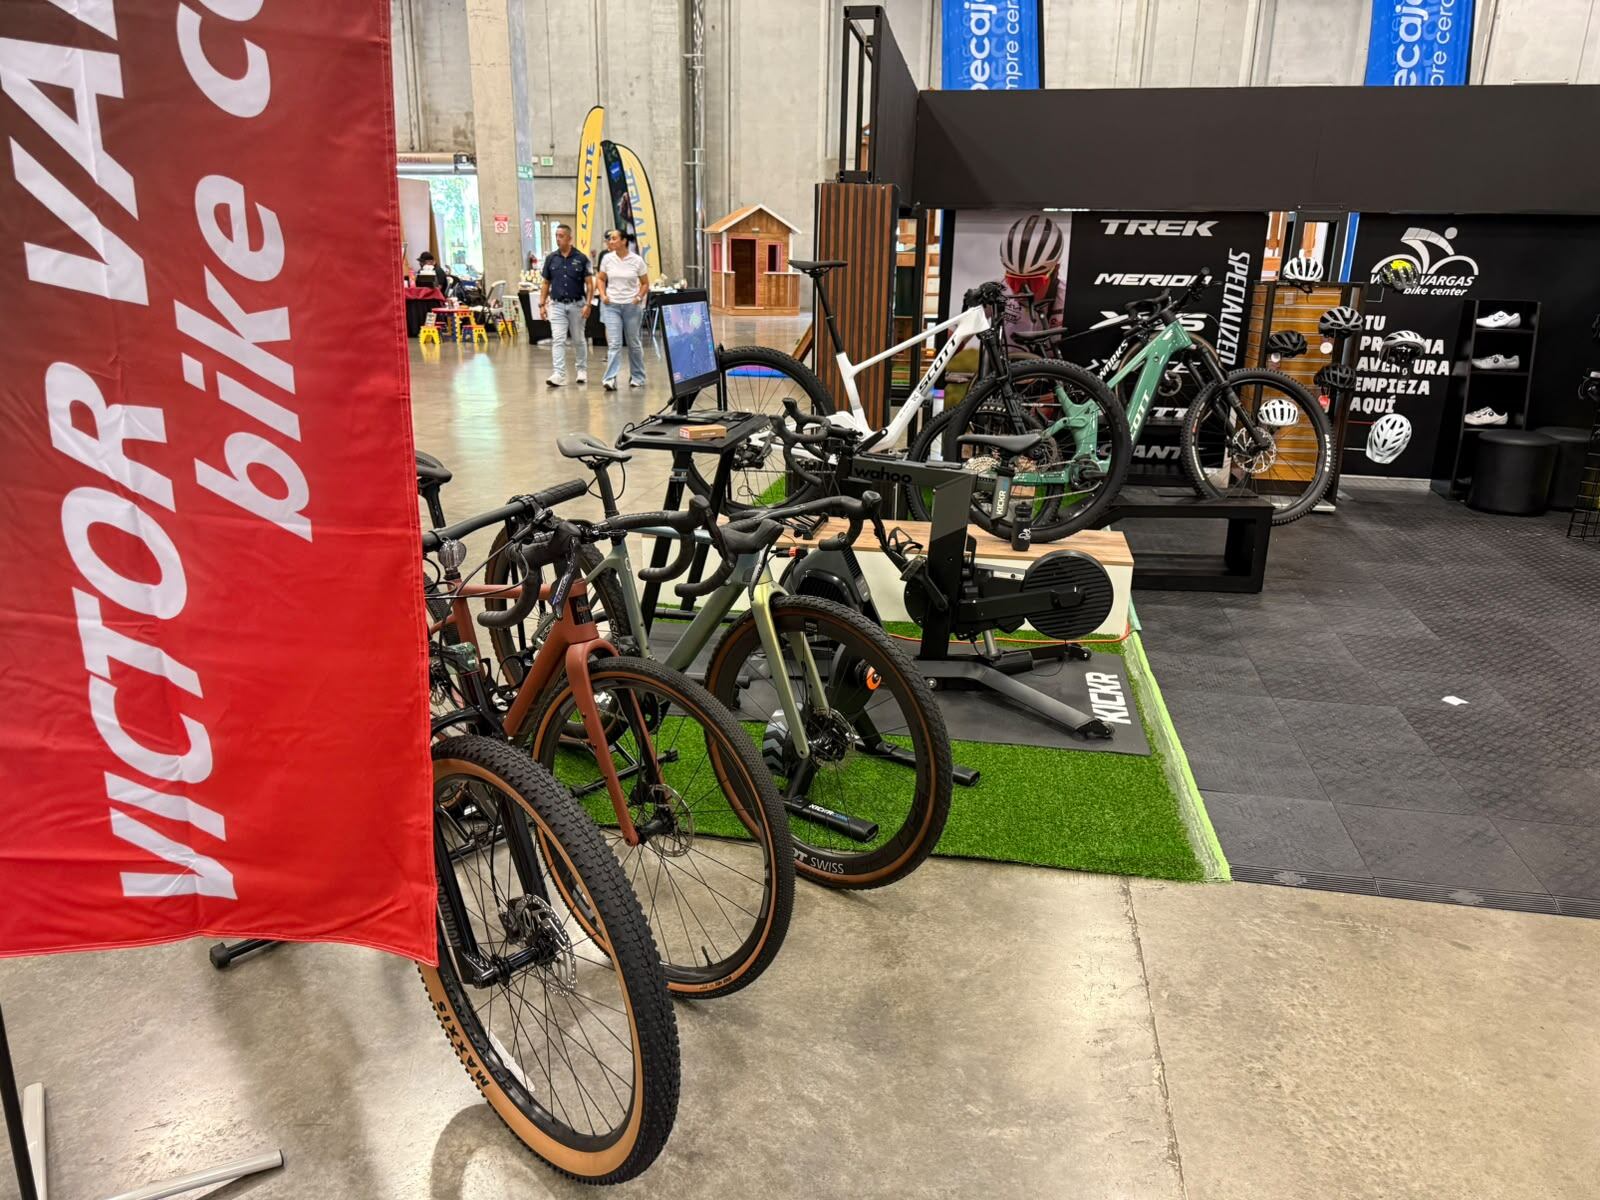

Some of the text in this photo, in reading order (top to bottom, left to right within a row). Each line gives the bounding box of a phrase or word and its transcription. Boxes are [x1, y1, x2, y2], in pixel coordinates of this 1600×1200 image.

[1100, 219, 1220, 237] TREK
[174, 0, 313, 543] bike c
[1420, 274, 1475, 286] VARGAS
[1430, 287, 1468, 296] center
[1216, 248, 1250, 366] SPECIALIZED
[1365, 314, 1386, 331] TU
[1356, 356, 1450, 376] AVENURA
[1355, 376, 1430, 395] EMPIEZA
[1350, 394, 1396, 414] AQUÍ
[854, 466, 912, 483] wahoo
[996, 490, 1007, 515] KICKR
[45, 361, 238, 899] VICTOR
[1085, 671, 1132, 725] KICKR
[810, 856, 845, 874] SWISS
[436, 1001, 490, 1087] MAXXIS
